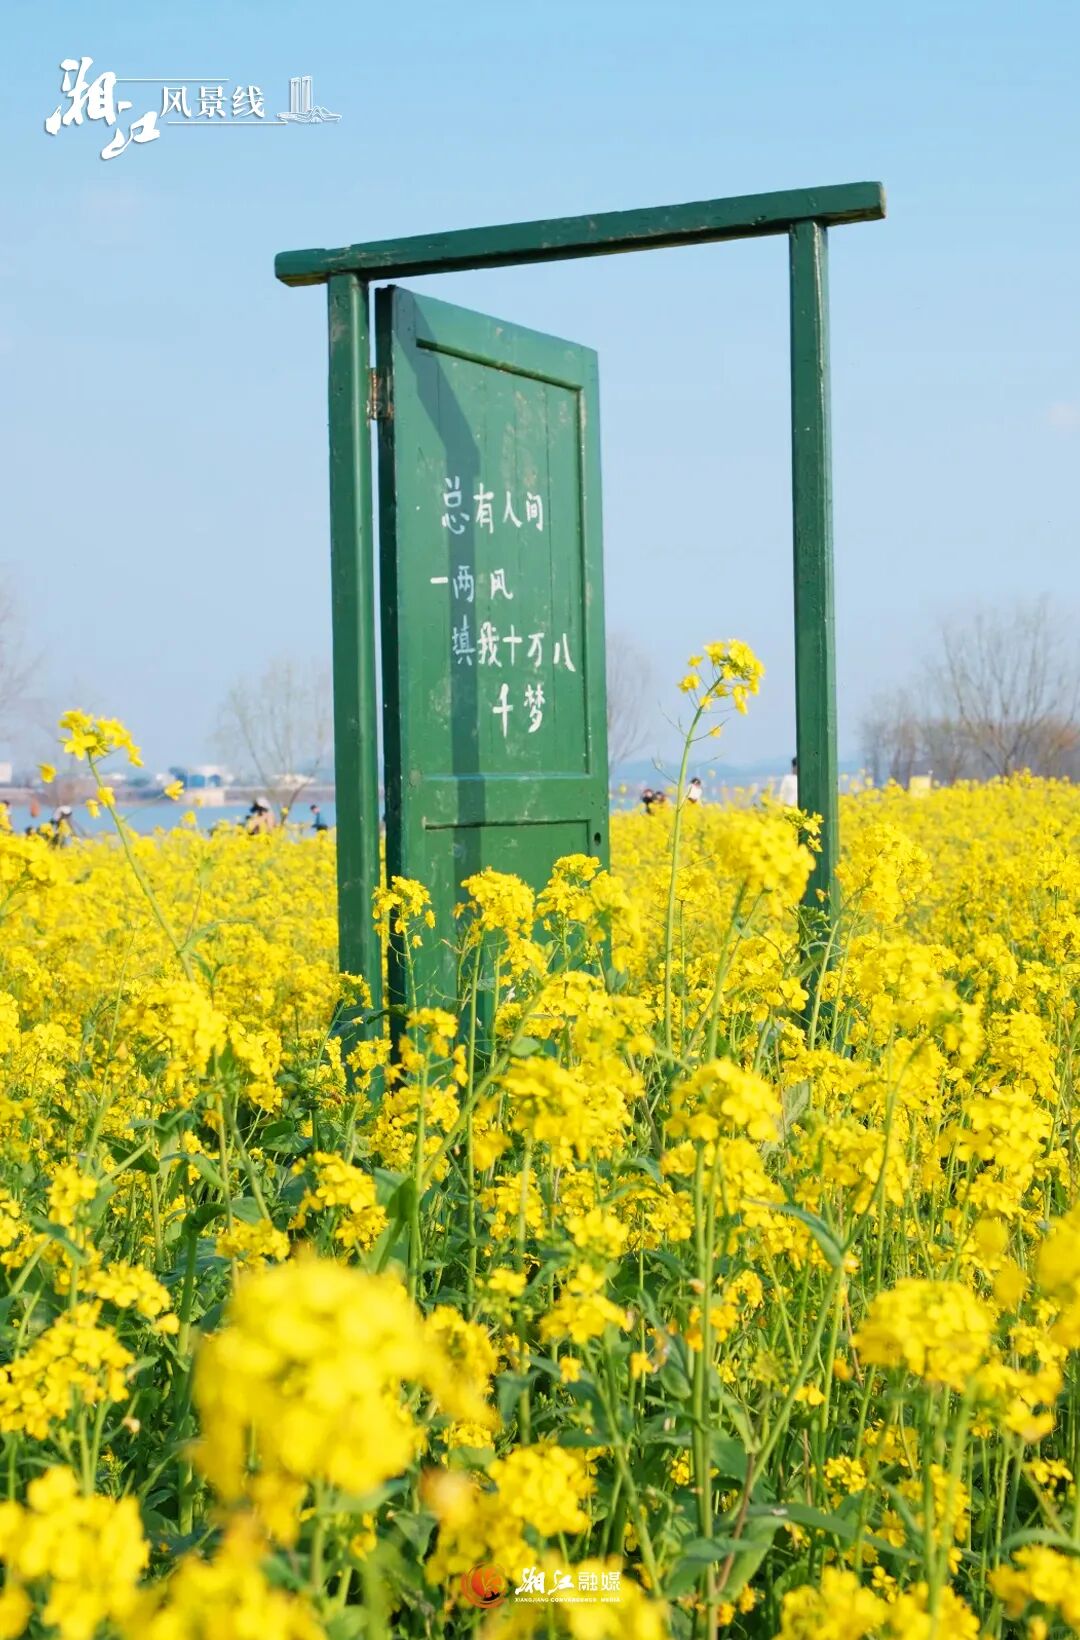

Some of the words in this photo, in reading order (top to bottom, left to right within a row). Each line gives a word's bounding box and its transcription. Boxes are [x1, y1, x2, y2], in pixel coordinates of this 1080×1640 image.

[441, 475, 545, 534] 总有人间
[430, 565, 514, 602] 一两风
[452, 614, 576, 672] 填我十万八
[492, 683, 546, 737] 千梦
